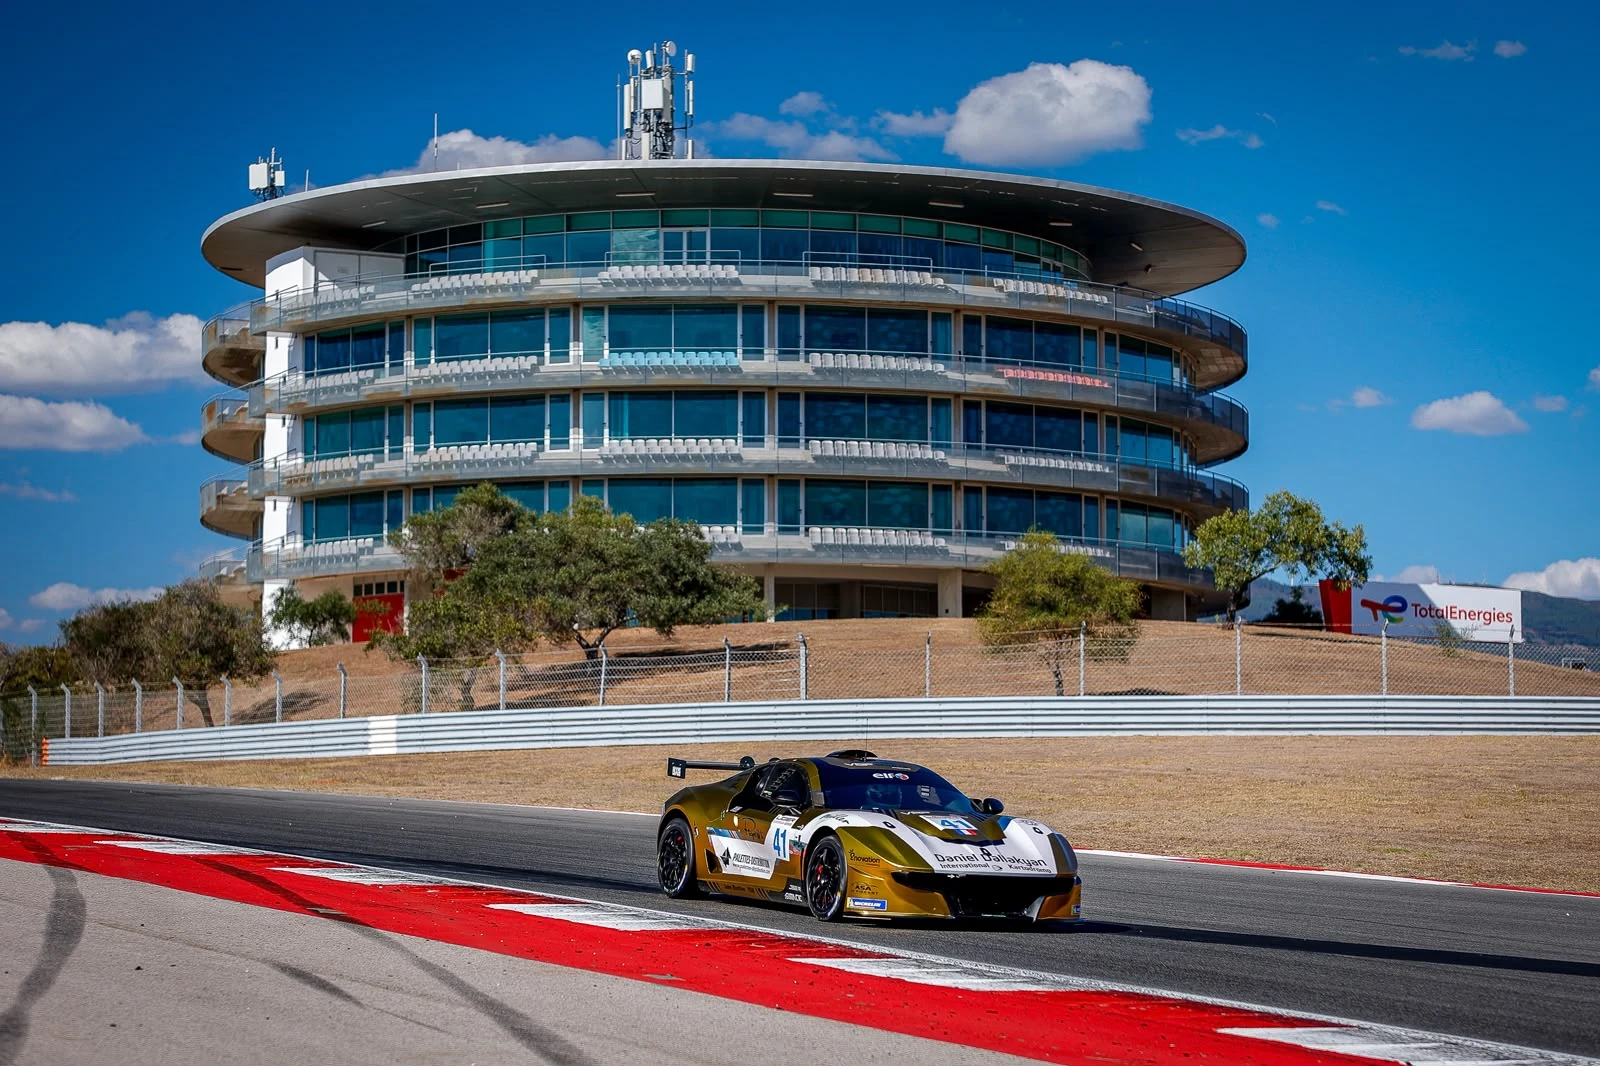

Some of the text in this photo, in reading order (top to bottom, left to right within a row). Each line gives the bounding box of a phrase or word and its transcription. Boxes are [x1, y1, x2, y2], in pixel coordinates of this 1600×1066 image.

[1411, 603, 1513, 626] TotalEnergies
[940, 819, 973, 829] 41
[773, 827, 787, 858] 41
[934, 853, 1047, 867] Daniel Dallakyan
[940, 862, 991, 870] International
